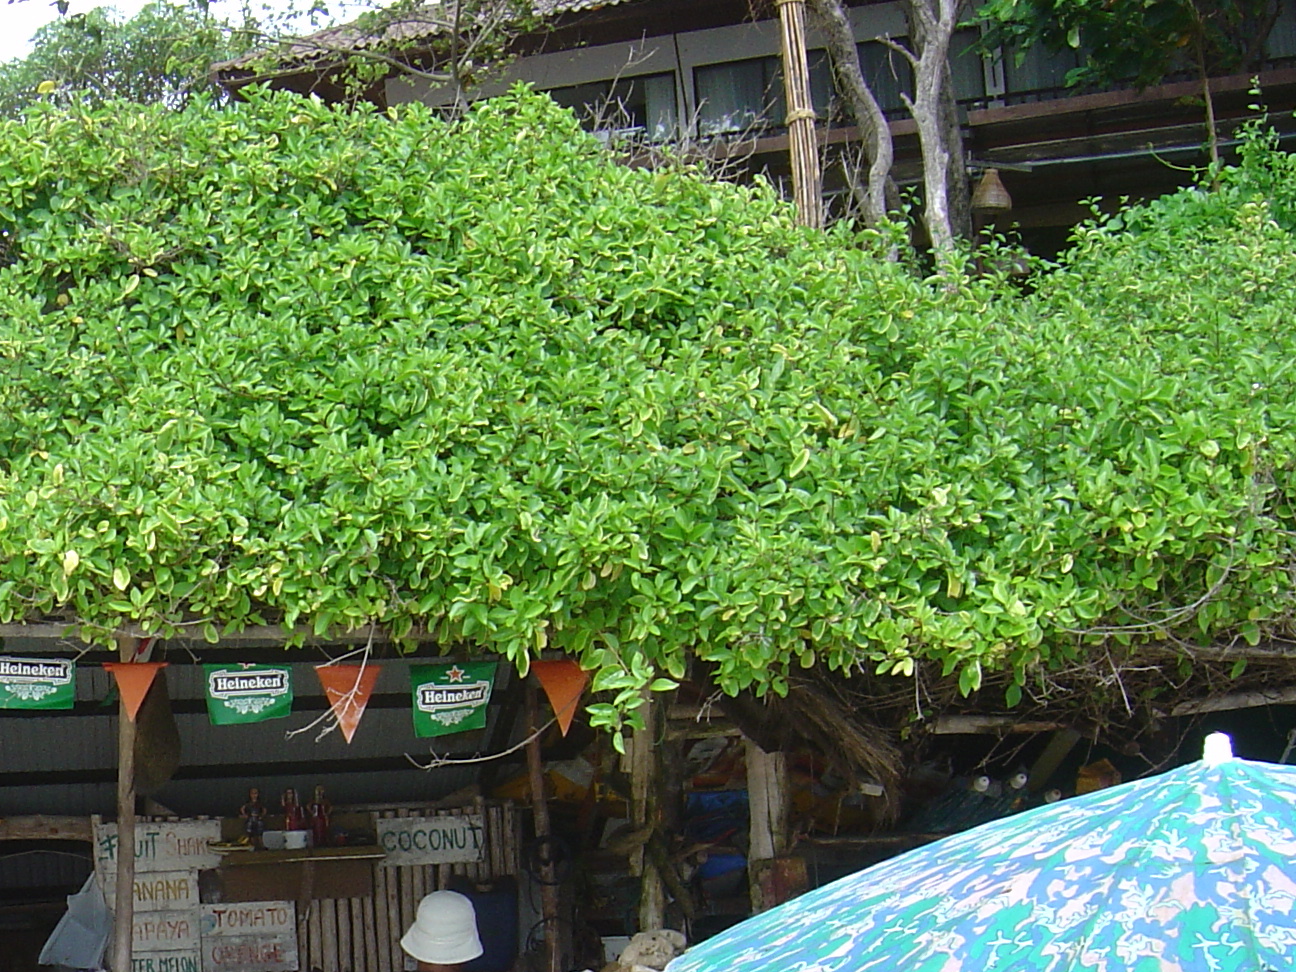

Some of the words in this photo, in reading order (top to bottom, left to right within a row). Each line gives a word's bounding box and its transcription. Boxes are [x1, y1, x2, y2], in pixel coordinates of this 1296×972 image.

[0, 662, 65, 677] Heineken
[217, 676, 282, 691] Heineken
[425, 690, 481, 704] Heineken
[98, 832, 160, 861] FUIT
[381, 826, 483, 852] COCONUT
[133, 879, 189, 901] ANANA
[212, 907, 288, 928] TOMATO
[133, 920, 190, 941] APAYA
